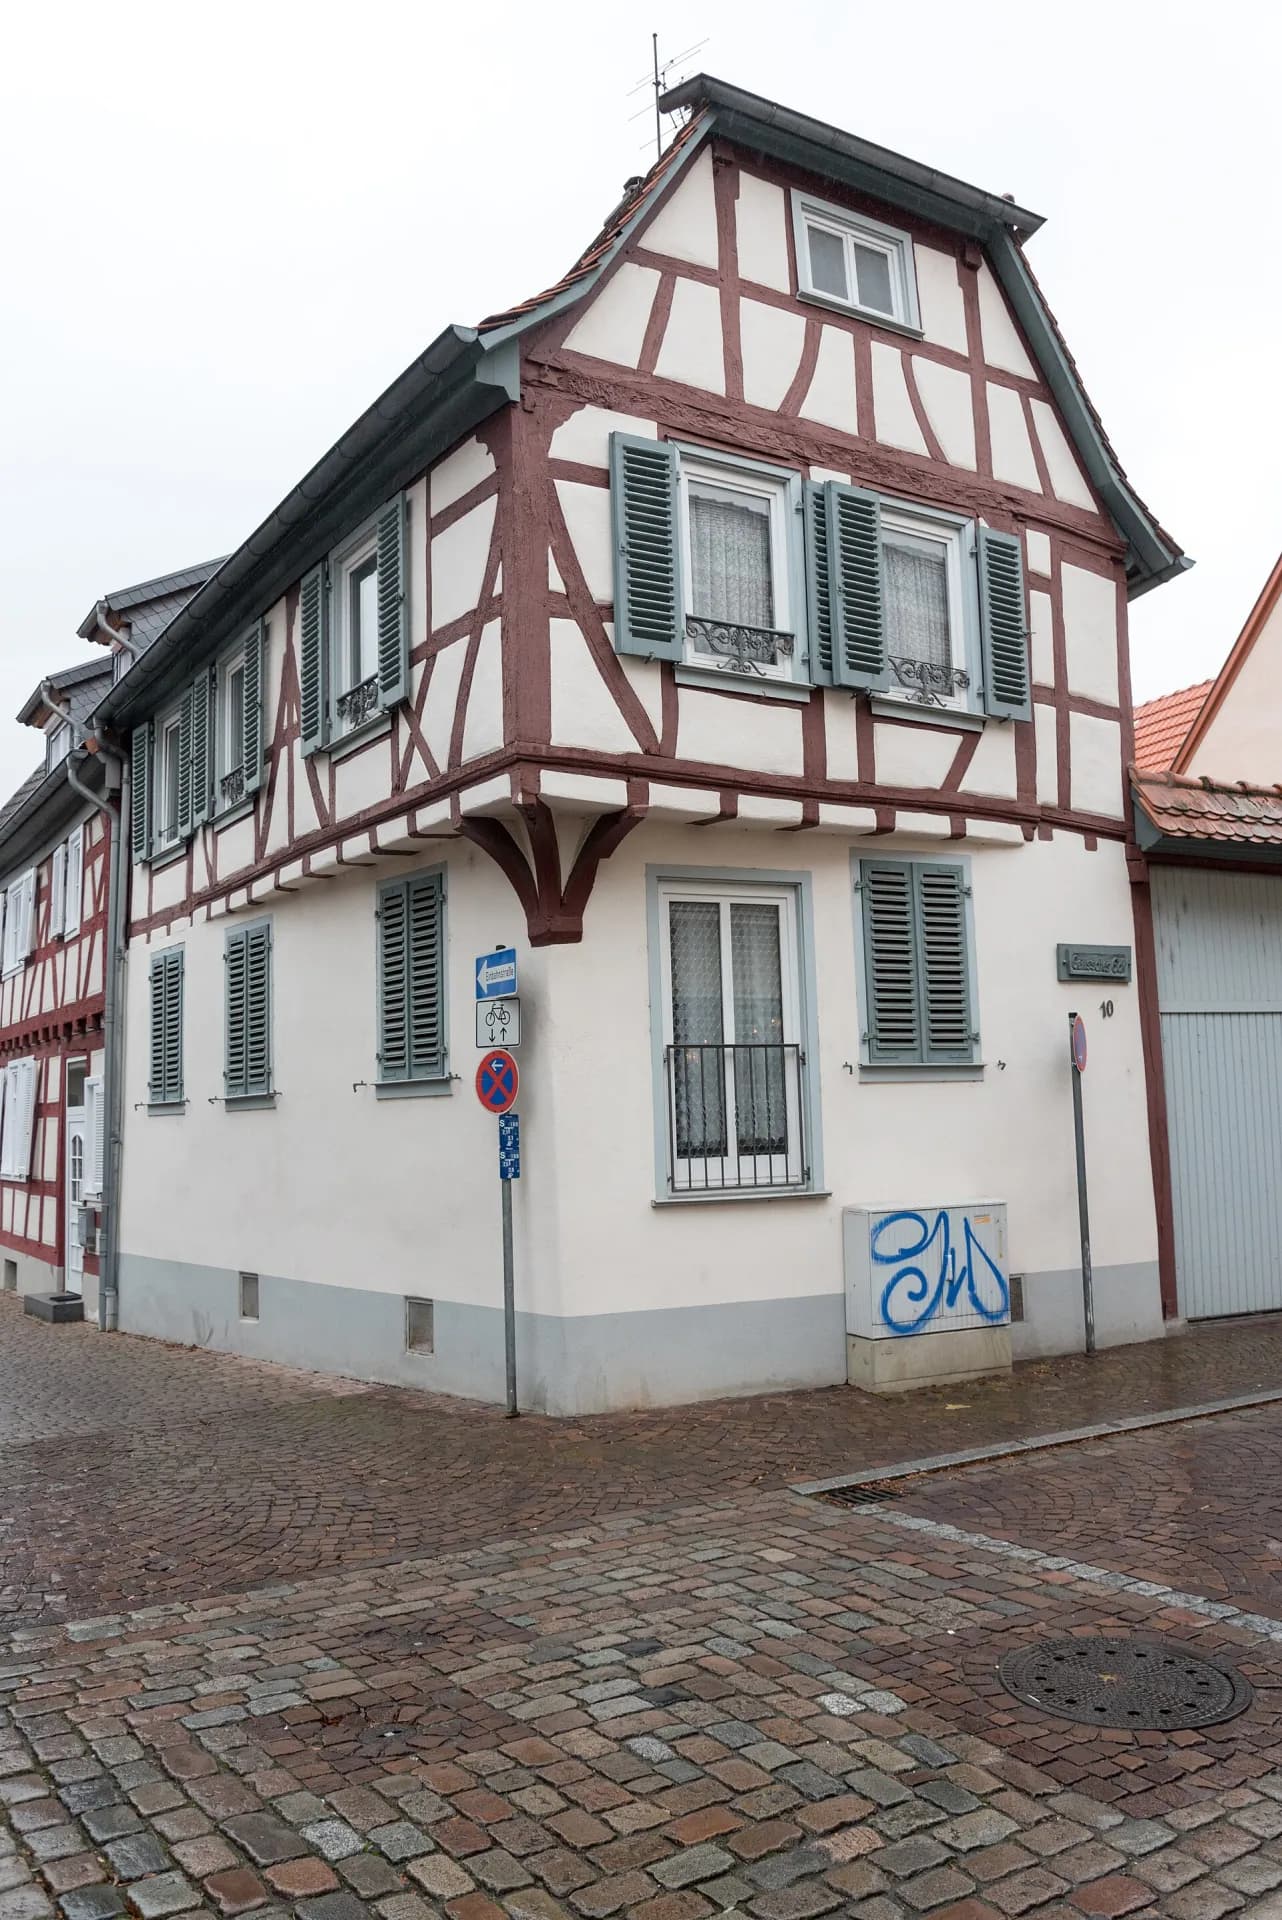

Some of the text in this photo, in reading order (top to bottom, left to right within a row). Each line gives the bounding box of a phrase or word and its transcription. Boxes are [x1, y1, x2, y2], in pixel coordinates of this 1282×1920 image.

[1099, 1000, 1114, 1019] 10
[499, 1119, 505, 1127] S
[500, 1151, 506, 1159] S
